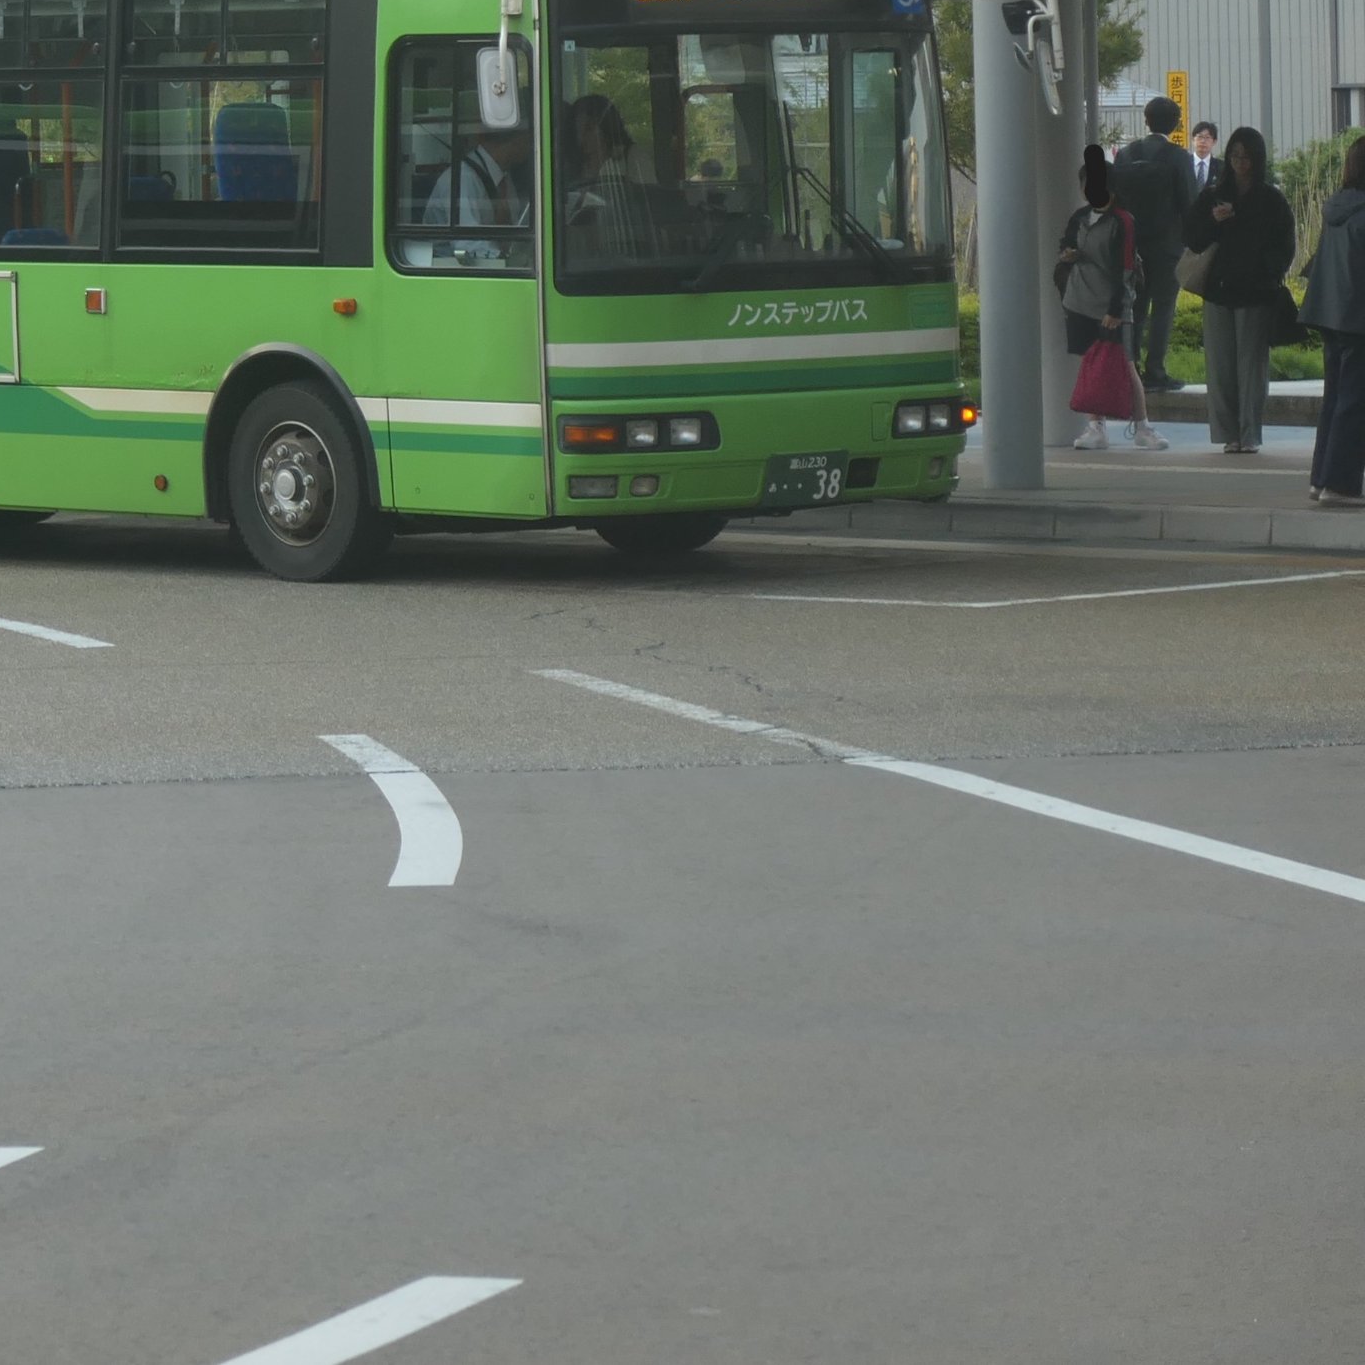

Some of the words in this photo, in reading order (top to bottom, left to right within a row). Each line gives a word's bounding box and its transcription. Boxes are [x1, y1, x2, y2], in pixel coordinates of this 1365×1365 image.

[728, 299, 868, 327] ノンステップバス
